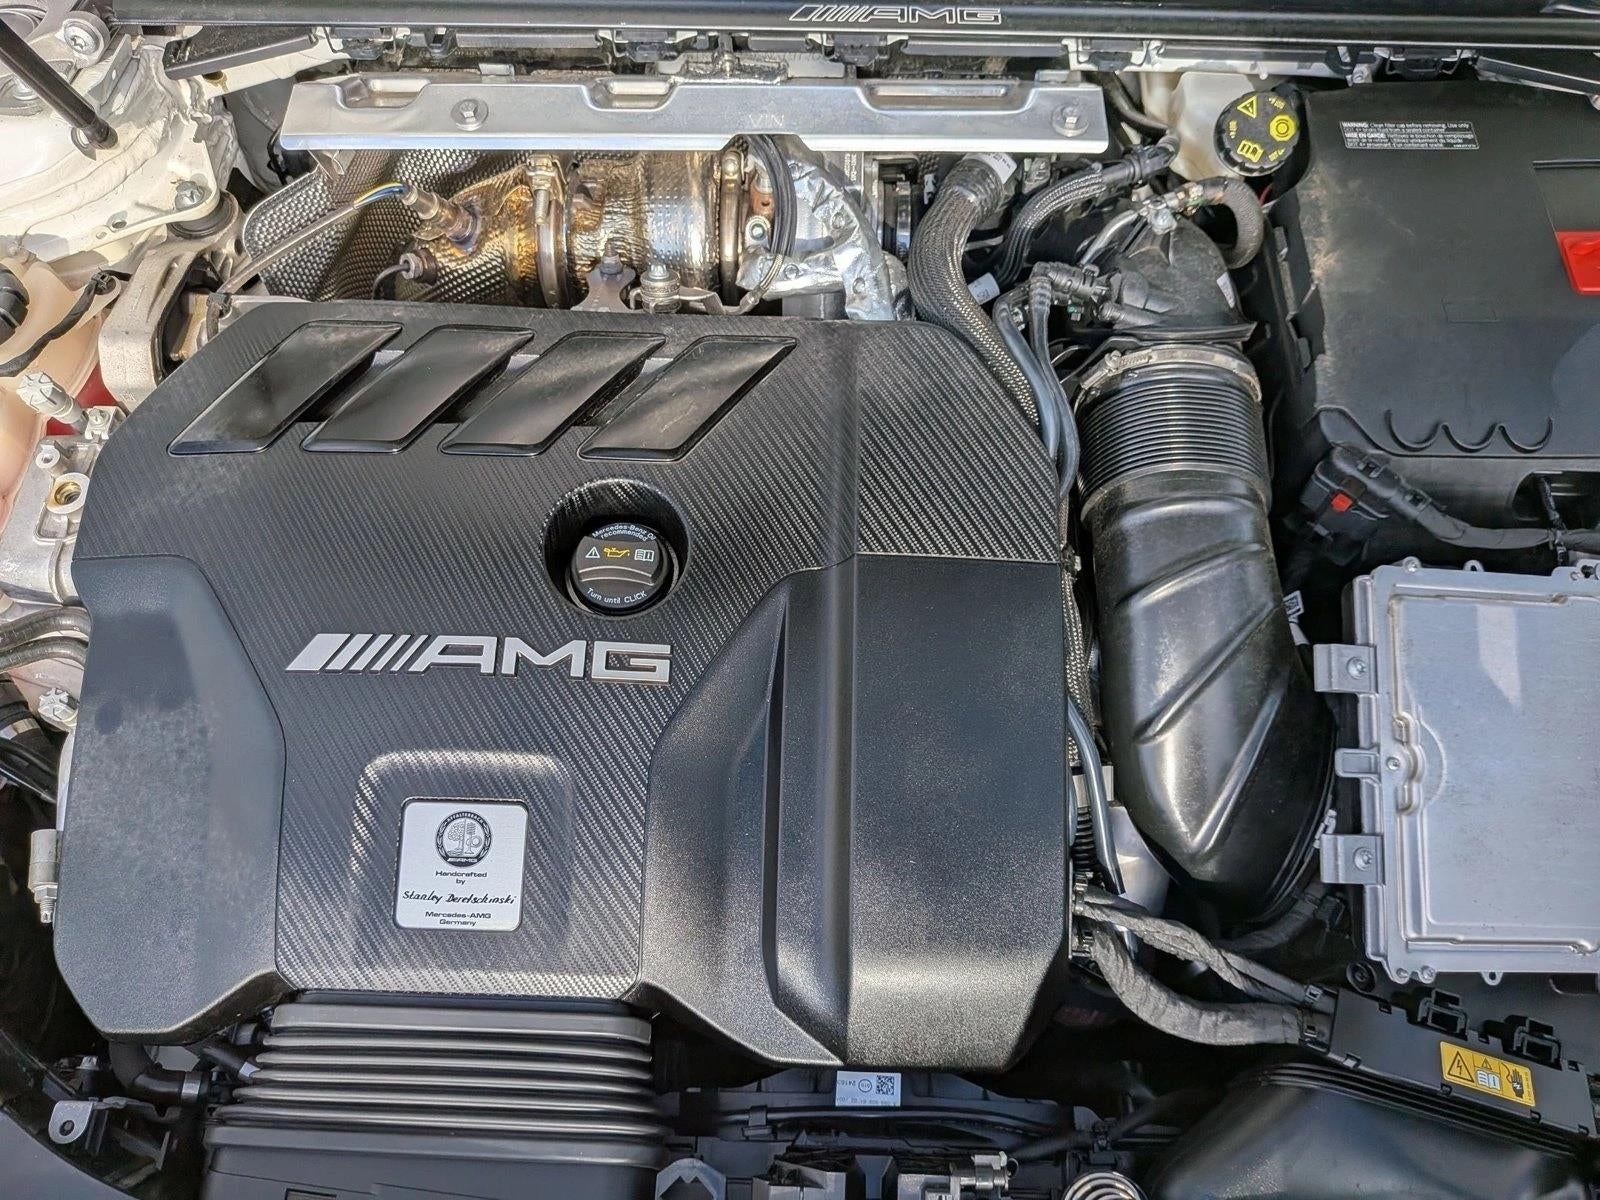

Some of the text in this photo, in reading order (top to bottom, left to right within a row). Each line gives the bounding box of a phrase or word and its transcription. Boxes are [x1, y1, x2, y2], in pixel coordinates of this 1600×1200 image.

[862, 5, 1002, 25] AMG
[592, 524, 647, 538] Mercedes-Benz
[600, 530, 648, 542] recommended
[586, 588, 602, 600] Turn
[624, 590, 648, 603] CLICK
[408, 635, 671, 682] AMG
[402, 890, 443, 904] Stanley
